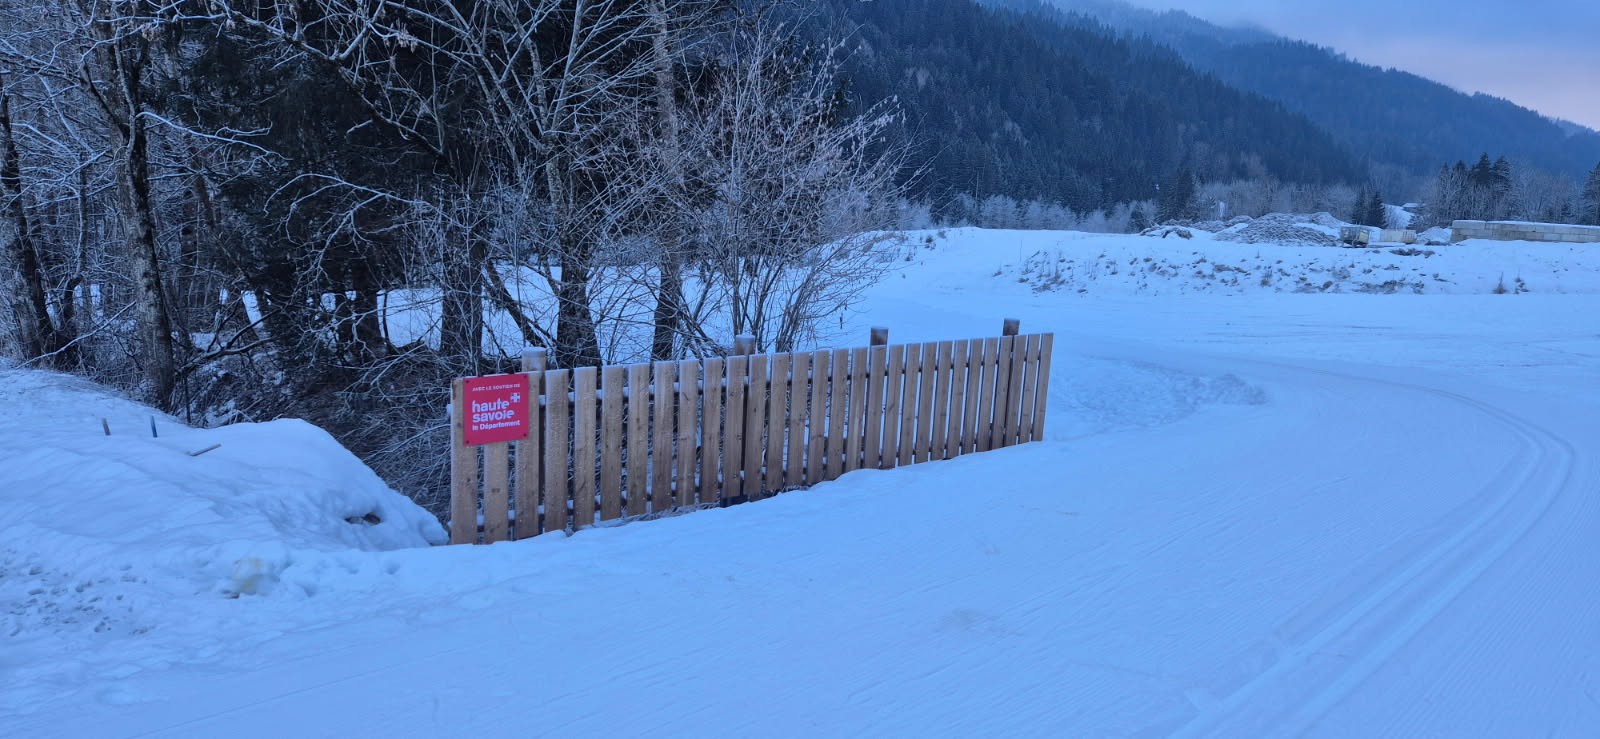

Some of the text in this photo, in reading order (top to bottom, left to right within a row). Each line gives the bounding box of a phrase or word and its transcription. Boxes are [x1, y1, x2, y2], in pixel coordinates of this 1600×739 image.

[472, 398, 509, 413] haute
[472, 410, 514, 423] savoie
[480, 420, 520, 430] Département
